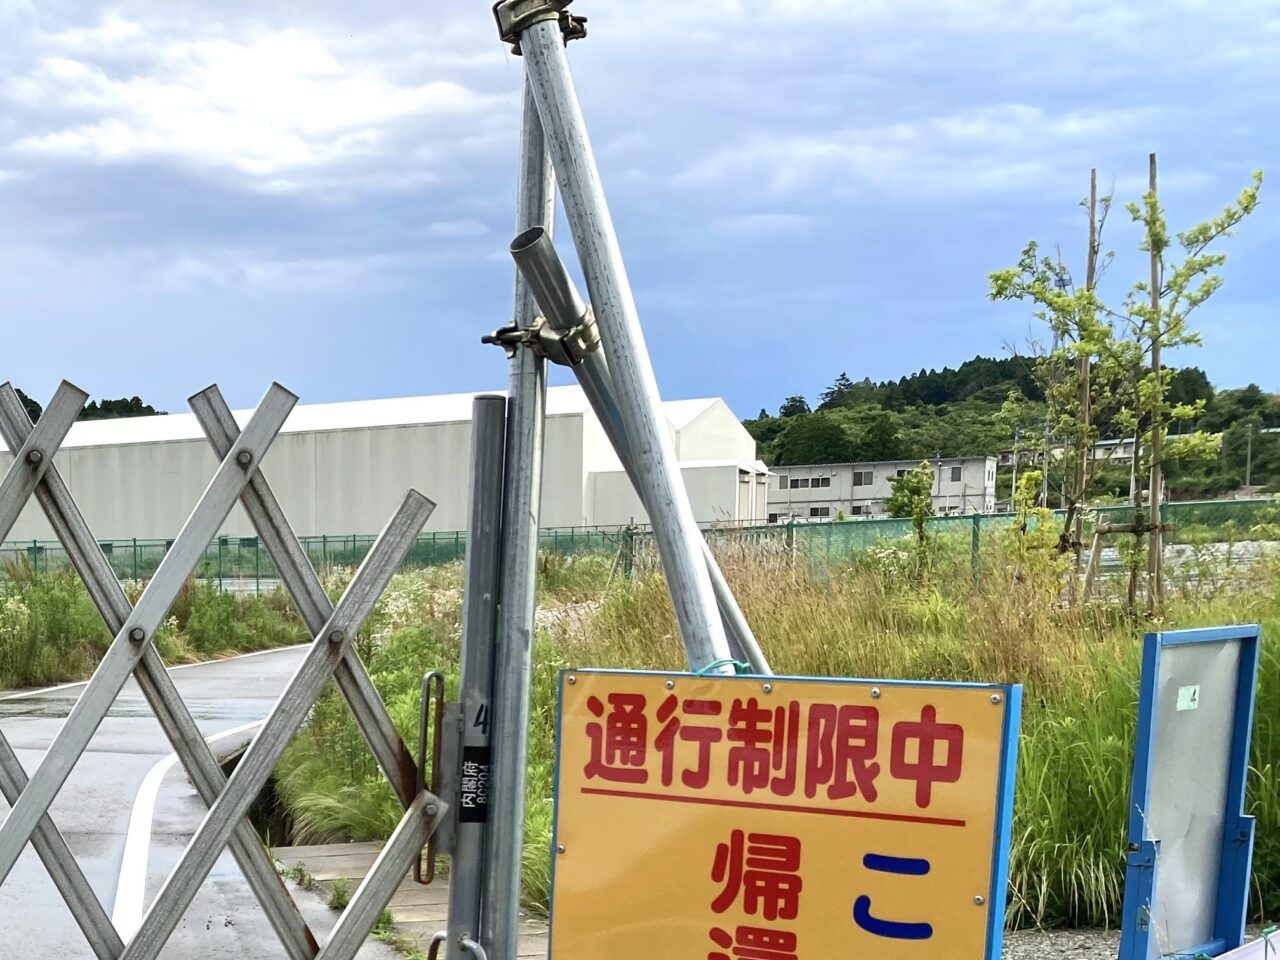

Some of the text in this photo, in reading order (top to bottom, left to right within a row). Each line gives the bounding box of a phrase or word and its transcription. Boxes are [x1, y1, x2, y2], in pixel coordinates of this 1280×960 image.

[473, 703, 489, 735] 4
[583, 692, 964, 808] 通行制限中
[460, 760, 479, 808] 内閣府
